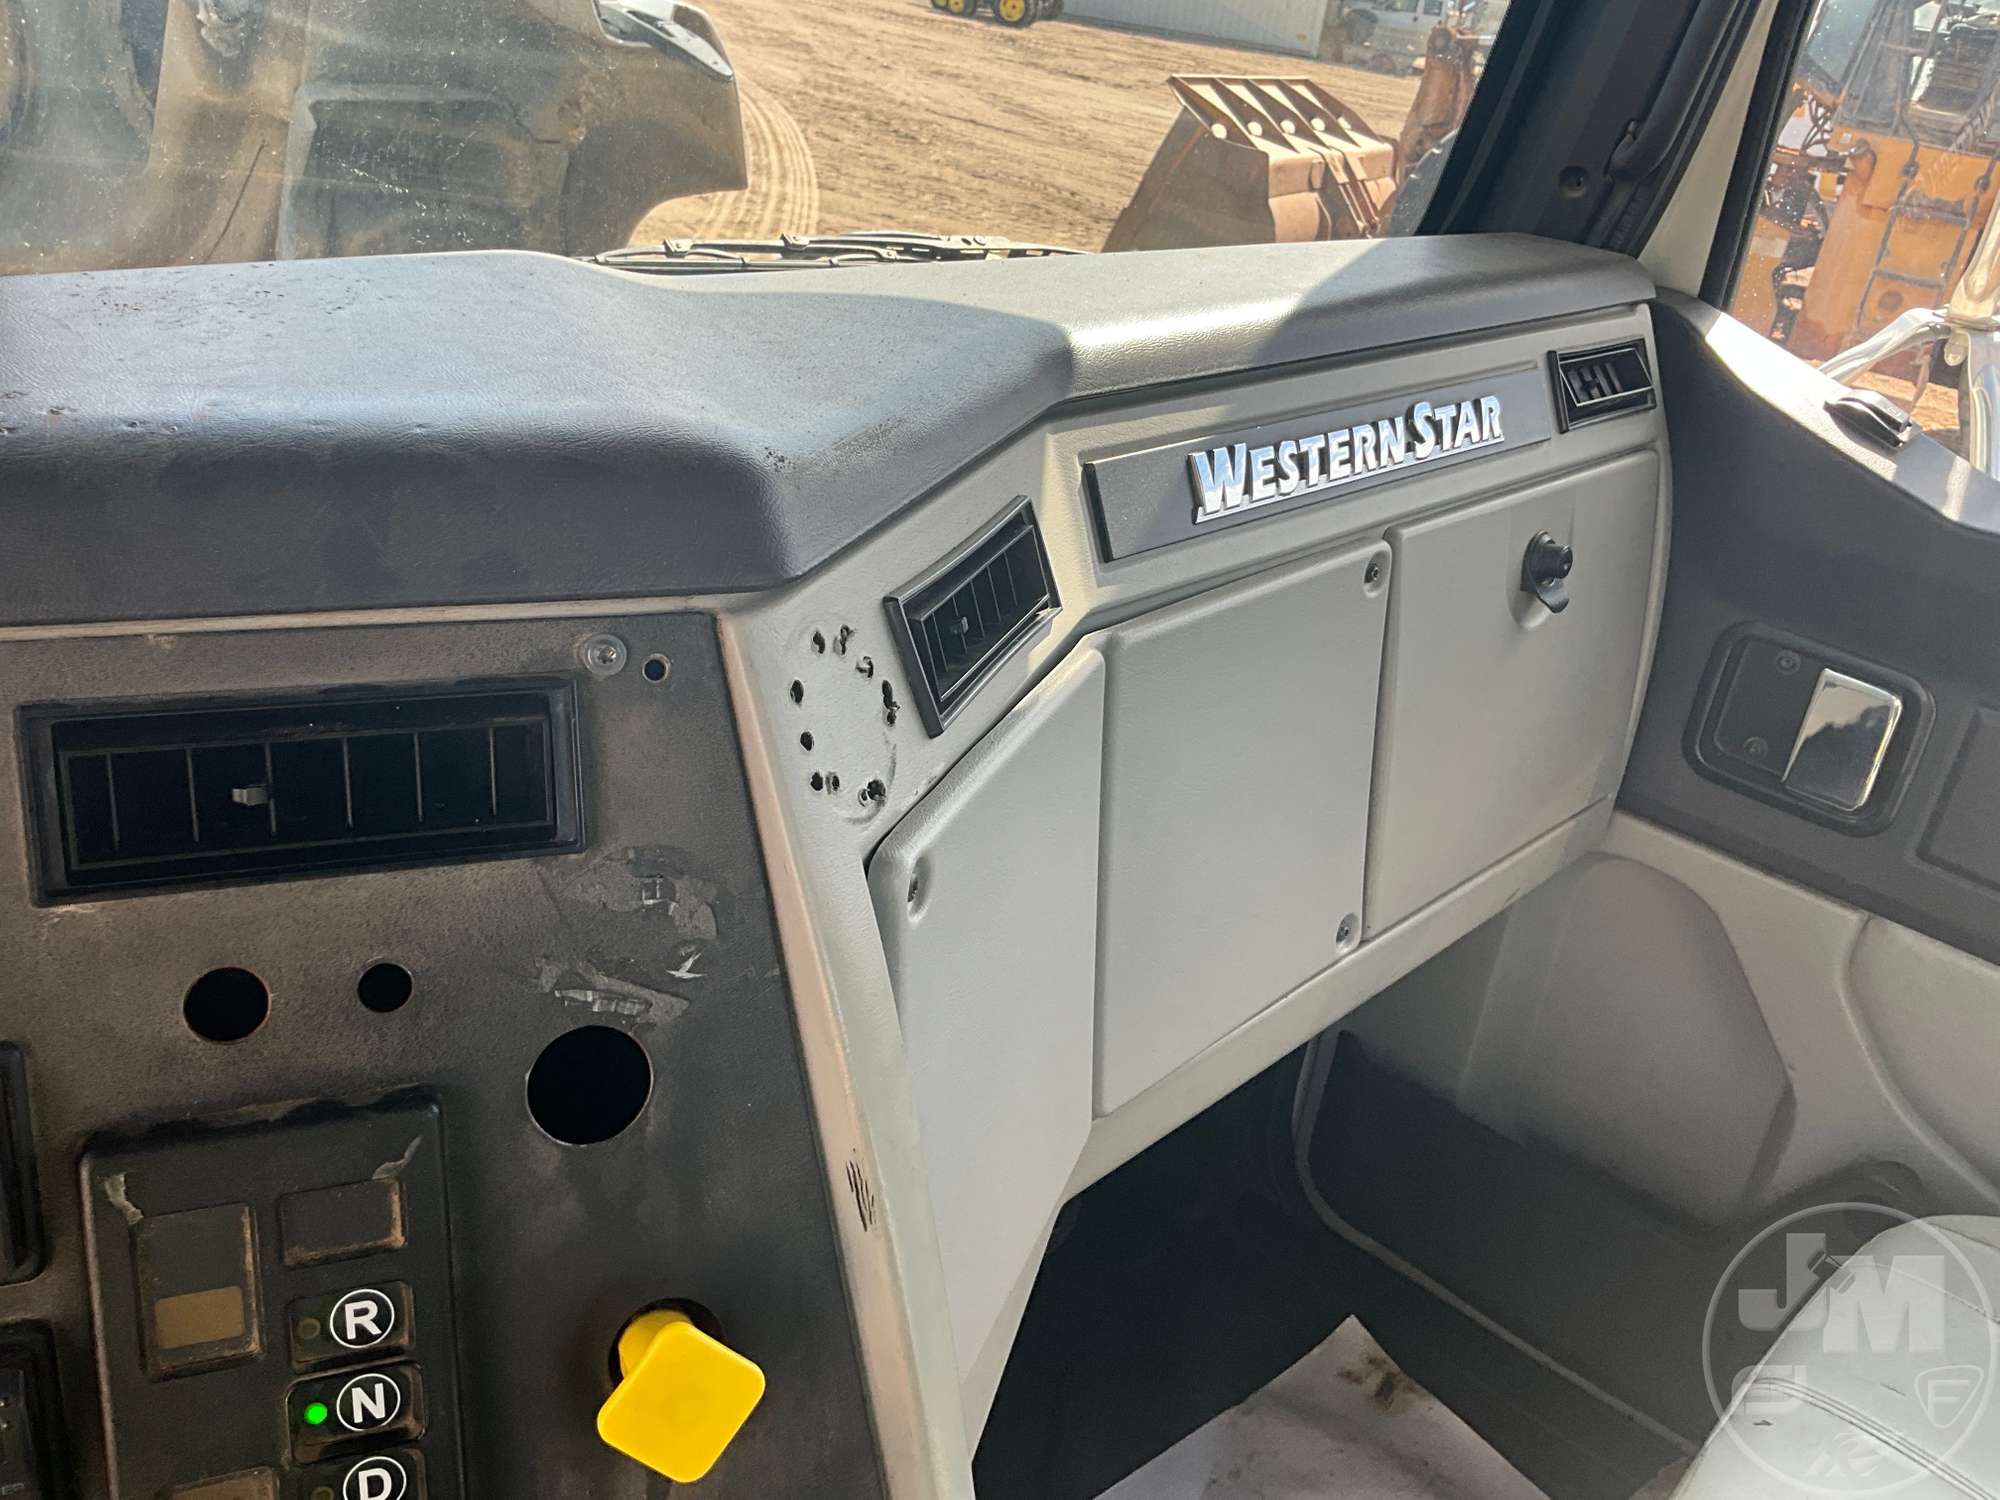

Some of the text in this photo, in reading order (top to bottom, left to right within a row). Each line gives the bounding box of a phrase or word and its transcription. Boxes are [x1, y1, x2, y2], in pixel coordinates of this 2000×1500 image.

[344, 1300, 382, 1340] R
[351, 1382, 387, 1423] N
[357, 1467, 393, 1500] D
